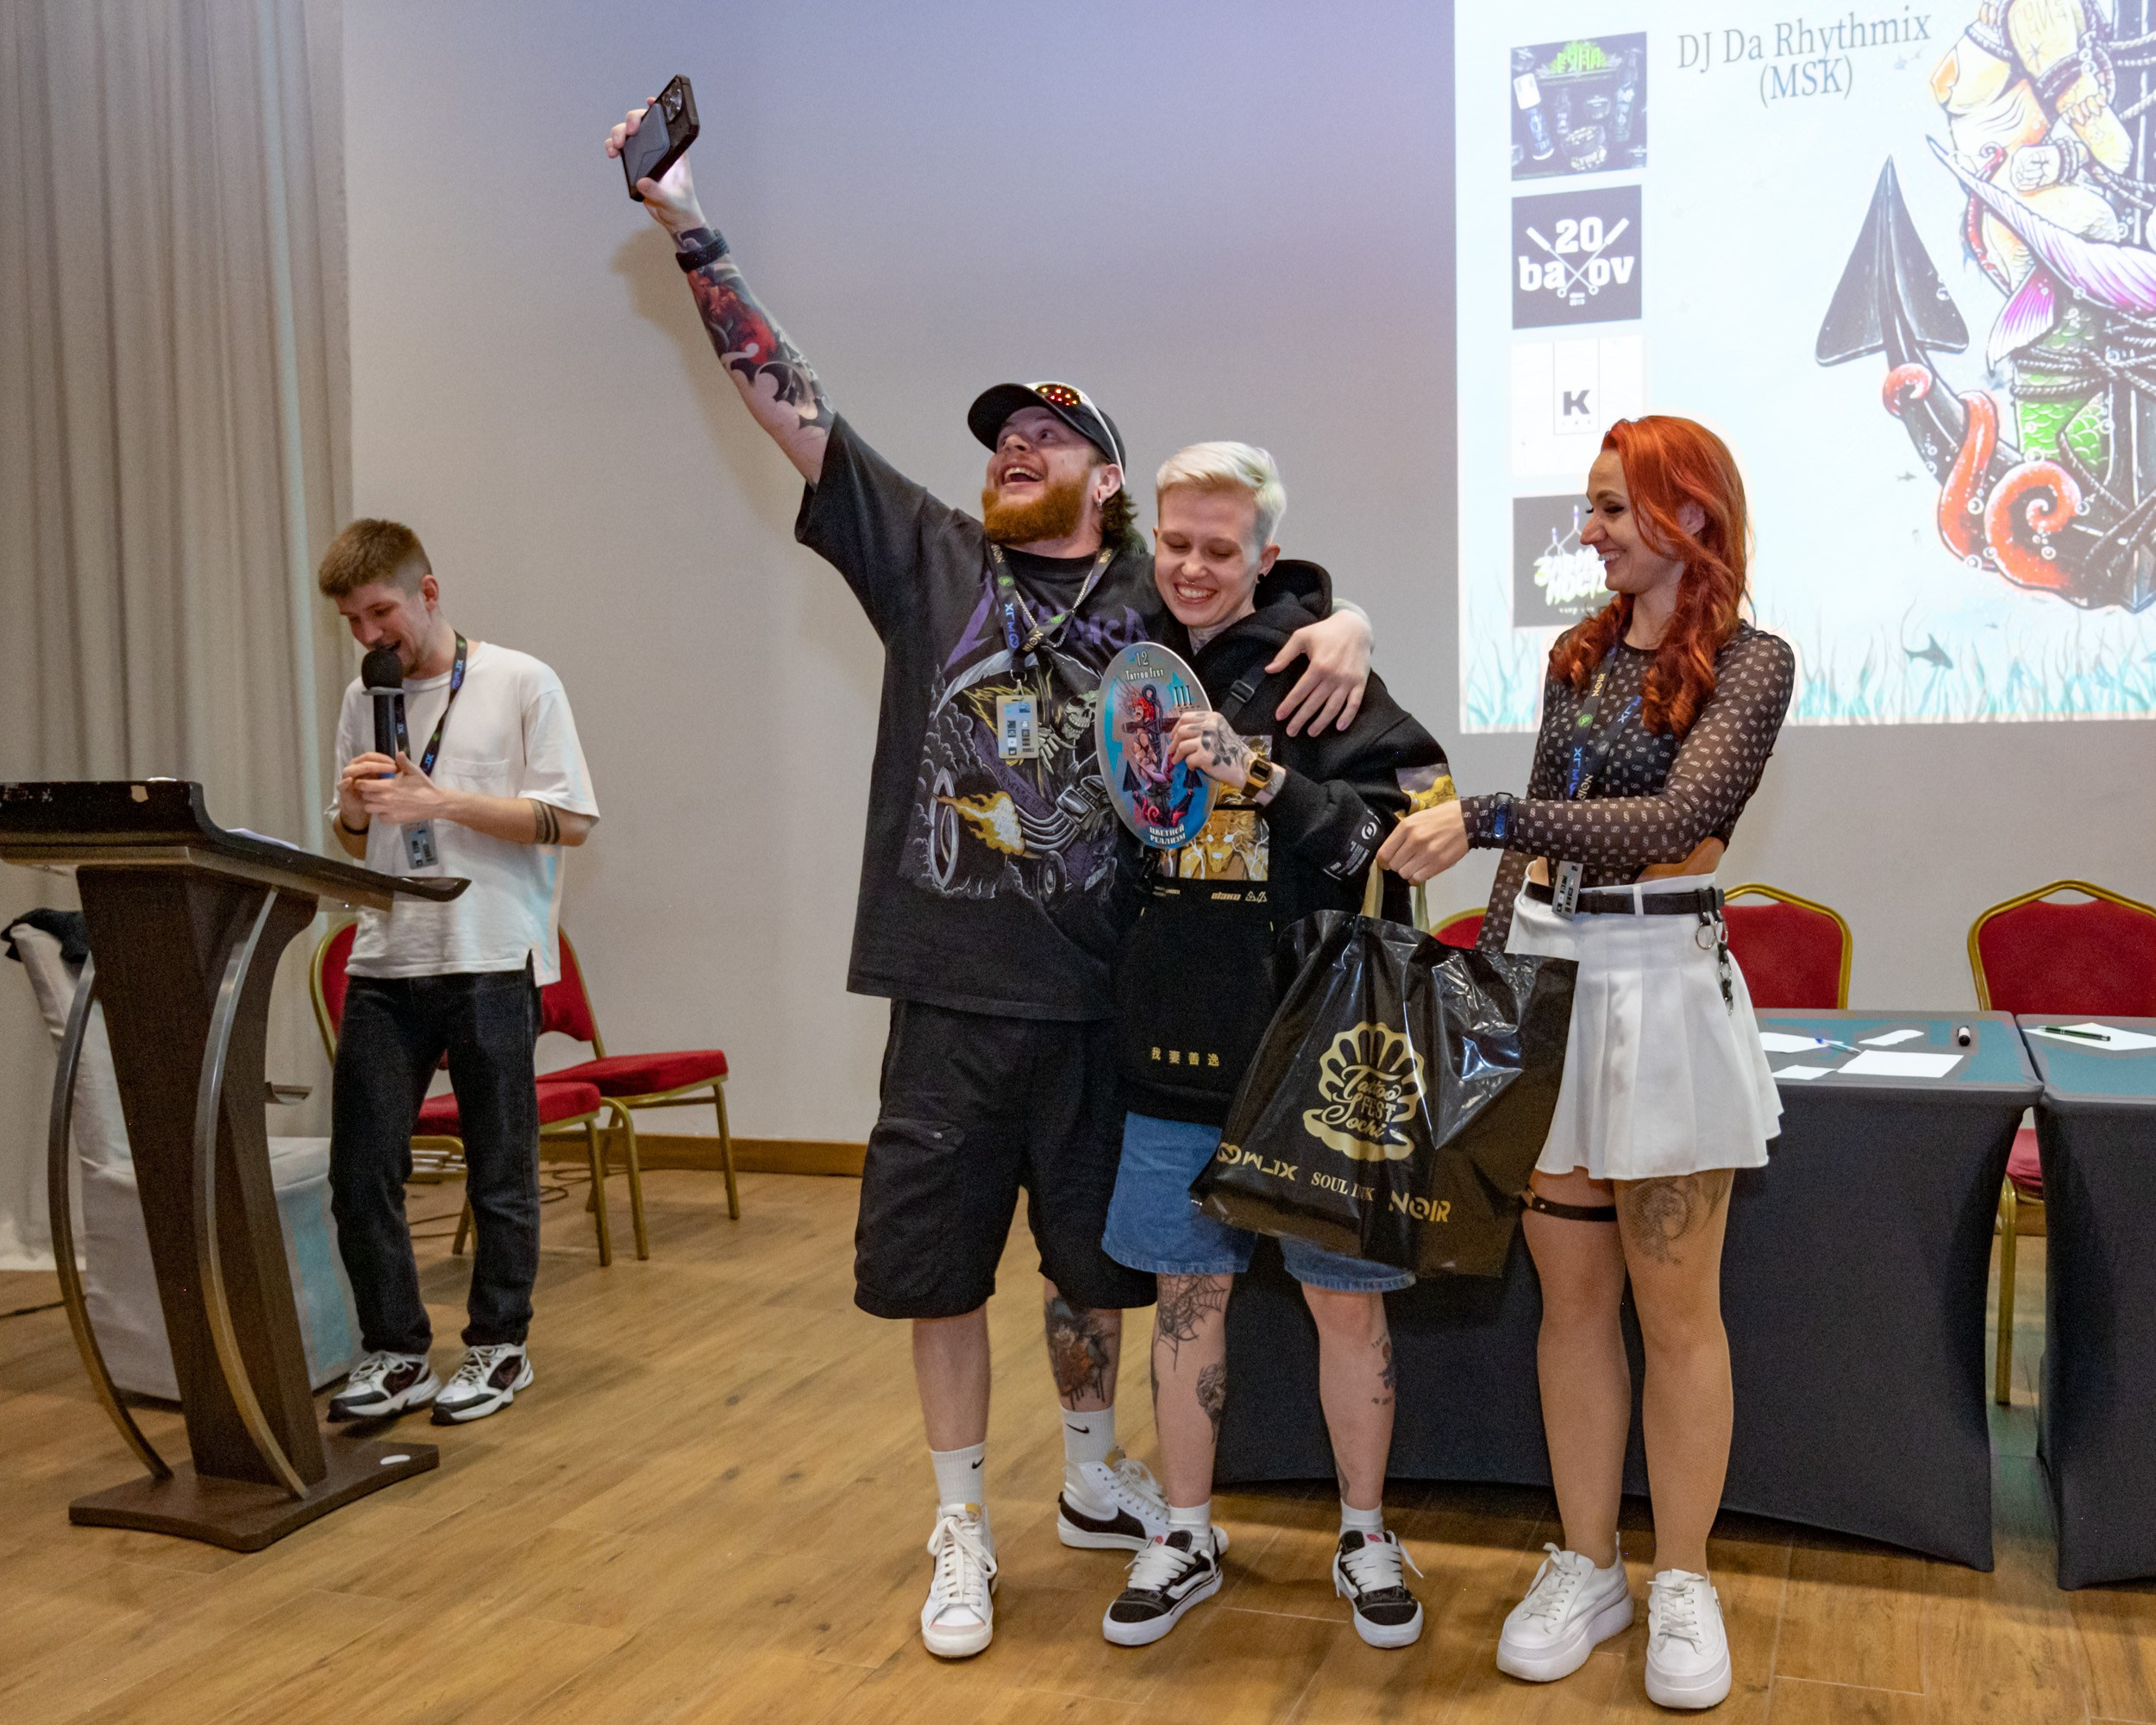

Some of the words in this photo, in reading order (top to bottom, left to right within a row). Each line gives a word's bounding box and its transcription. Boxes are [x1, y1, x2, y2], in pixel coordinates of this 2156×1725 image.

[1677, 32, 1712, 73] DJ
[1723, 28, 1764, 63] Da
[1774, 5, 1932, 64] Rhythmix
[1760, 54, 1852, 108] (MSK)
[1555, 216, 1603, 254] 20
[1563, 389, 1591, 416] K
[1136, 650, 1149, 667] 12
[1591, 673, 1606, 697] NOIR
[1150, 823, 1184, 837] ЦВЕТНОЙ
[1150, 832, 1186, 844] РЕАЛИЗМ
[1341, 1065, 1402, 1102] Tattoo
[1321, 1093, 1385, 1138] Sochi
[1361, 1095, 1397, 1122] FEST
[1311, 1170, 1349, 1195] SOUL
[1388, 1189, 1451, 1223] NOIR
